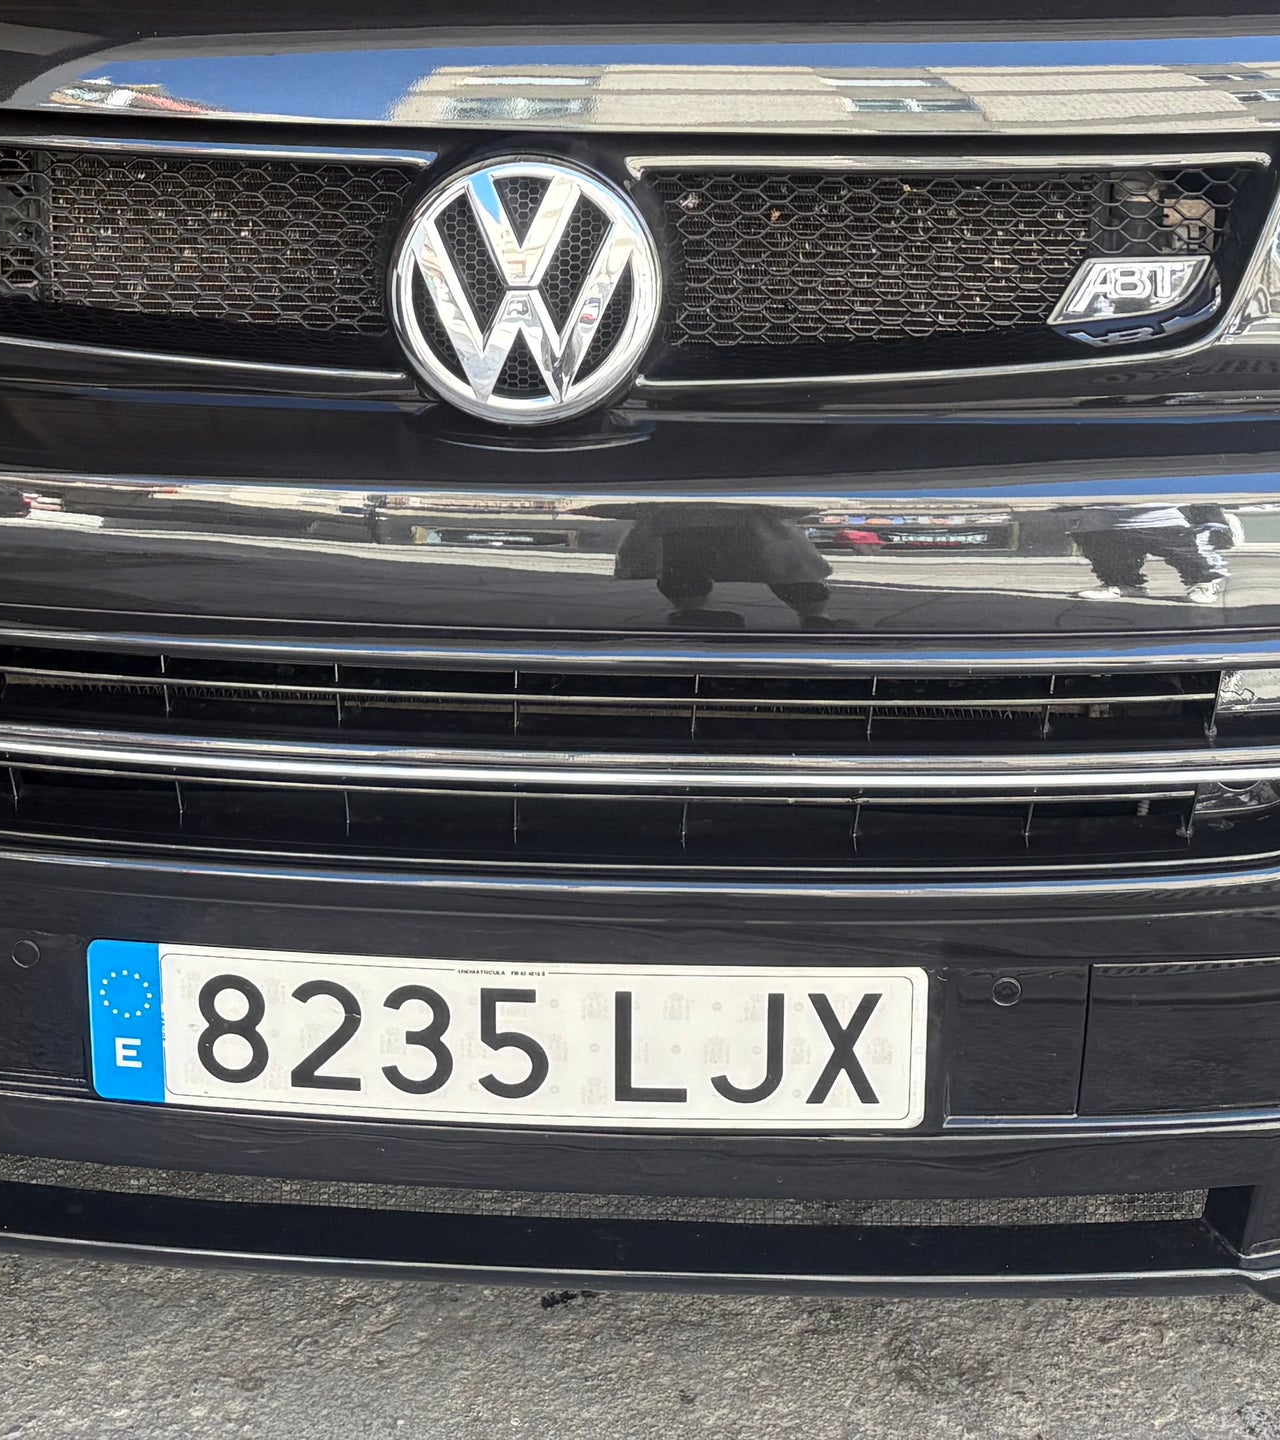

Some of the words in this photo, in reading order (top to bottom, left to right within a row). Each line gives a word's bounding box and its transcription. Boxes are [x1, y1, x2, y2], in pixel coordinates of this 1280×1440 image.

[1065, 261, 1186, 313] ABT
[114, 1036, 143, 1069] E
[197, 973, 550, 1099] 8235
[614, 990, 884, 1104] LJX
